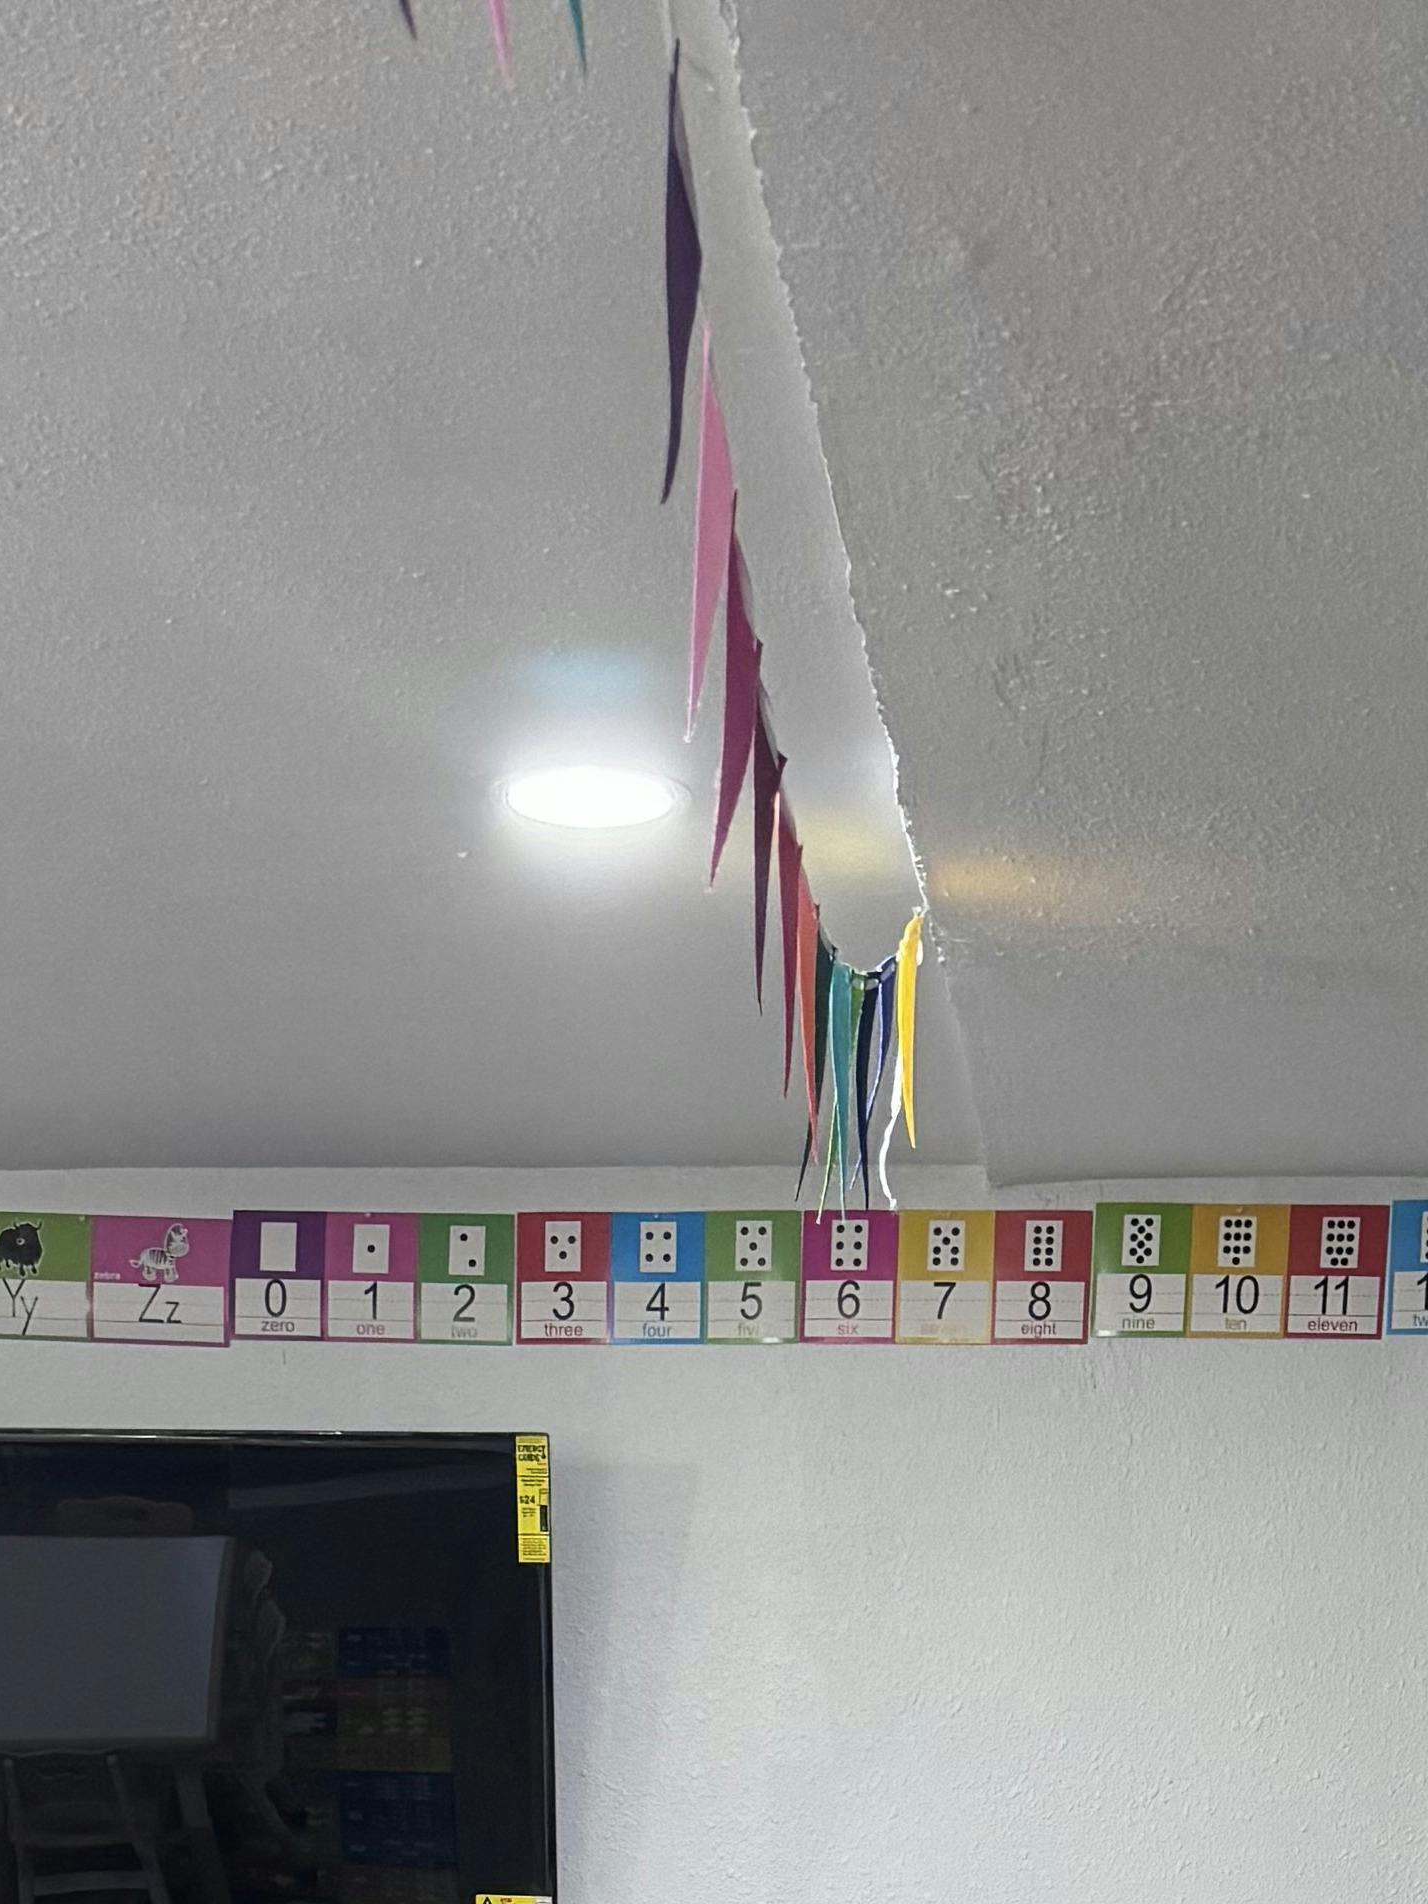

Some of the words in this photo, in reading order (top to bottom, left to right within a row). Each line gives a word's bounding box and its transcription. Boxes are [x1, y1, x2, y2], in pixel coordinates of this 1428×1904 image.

[2, 1278, 39, 1336] Yy
[138, 1283, 182, 1324] Zz
[264, 1278, 288, 1318] 0
[364, 1281, 378, 1320] 1
[452, 1284, 476, 1323] 2
[552, 1281, 575, 1321] 3
[645, 1282, 670, 1321] 4
[739, 1281, 763, 1320] 5
[837, 1280, 861, 1320] 6
[933, 1281, 957, 1320] 7
[1028, 1281, 1052, 1321] 8
[1128, 1273, 1153, 1314] 9
[1214, 1274, 1260, 1314] 10
[1314, 1275, 1349, 1316] 11
[261, 1320, 295, 1333] zero
[356, 1323, 385, 1336] one
[451, 1325, 478, 1338] two
[544, 1322, 583, 1337] three
[642, 1322, 672, 1338] four
[837, 1323, 859, 1336] six
[1021, 1321, 1057, 1338] eight
[1122, 1316, 1155, 1330] nine
[1225, 1316, 1247, 1330] ten
[1307, 1315, 1358, 1332] eleven
